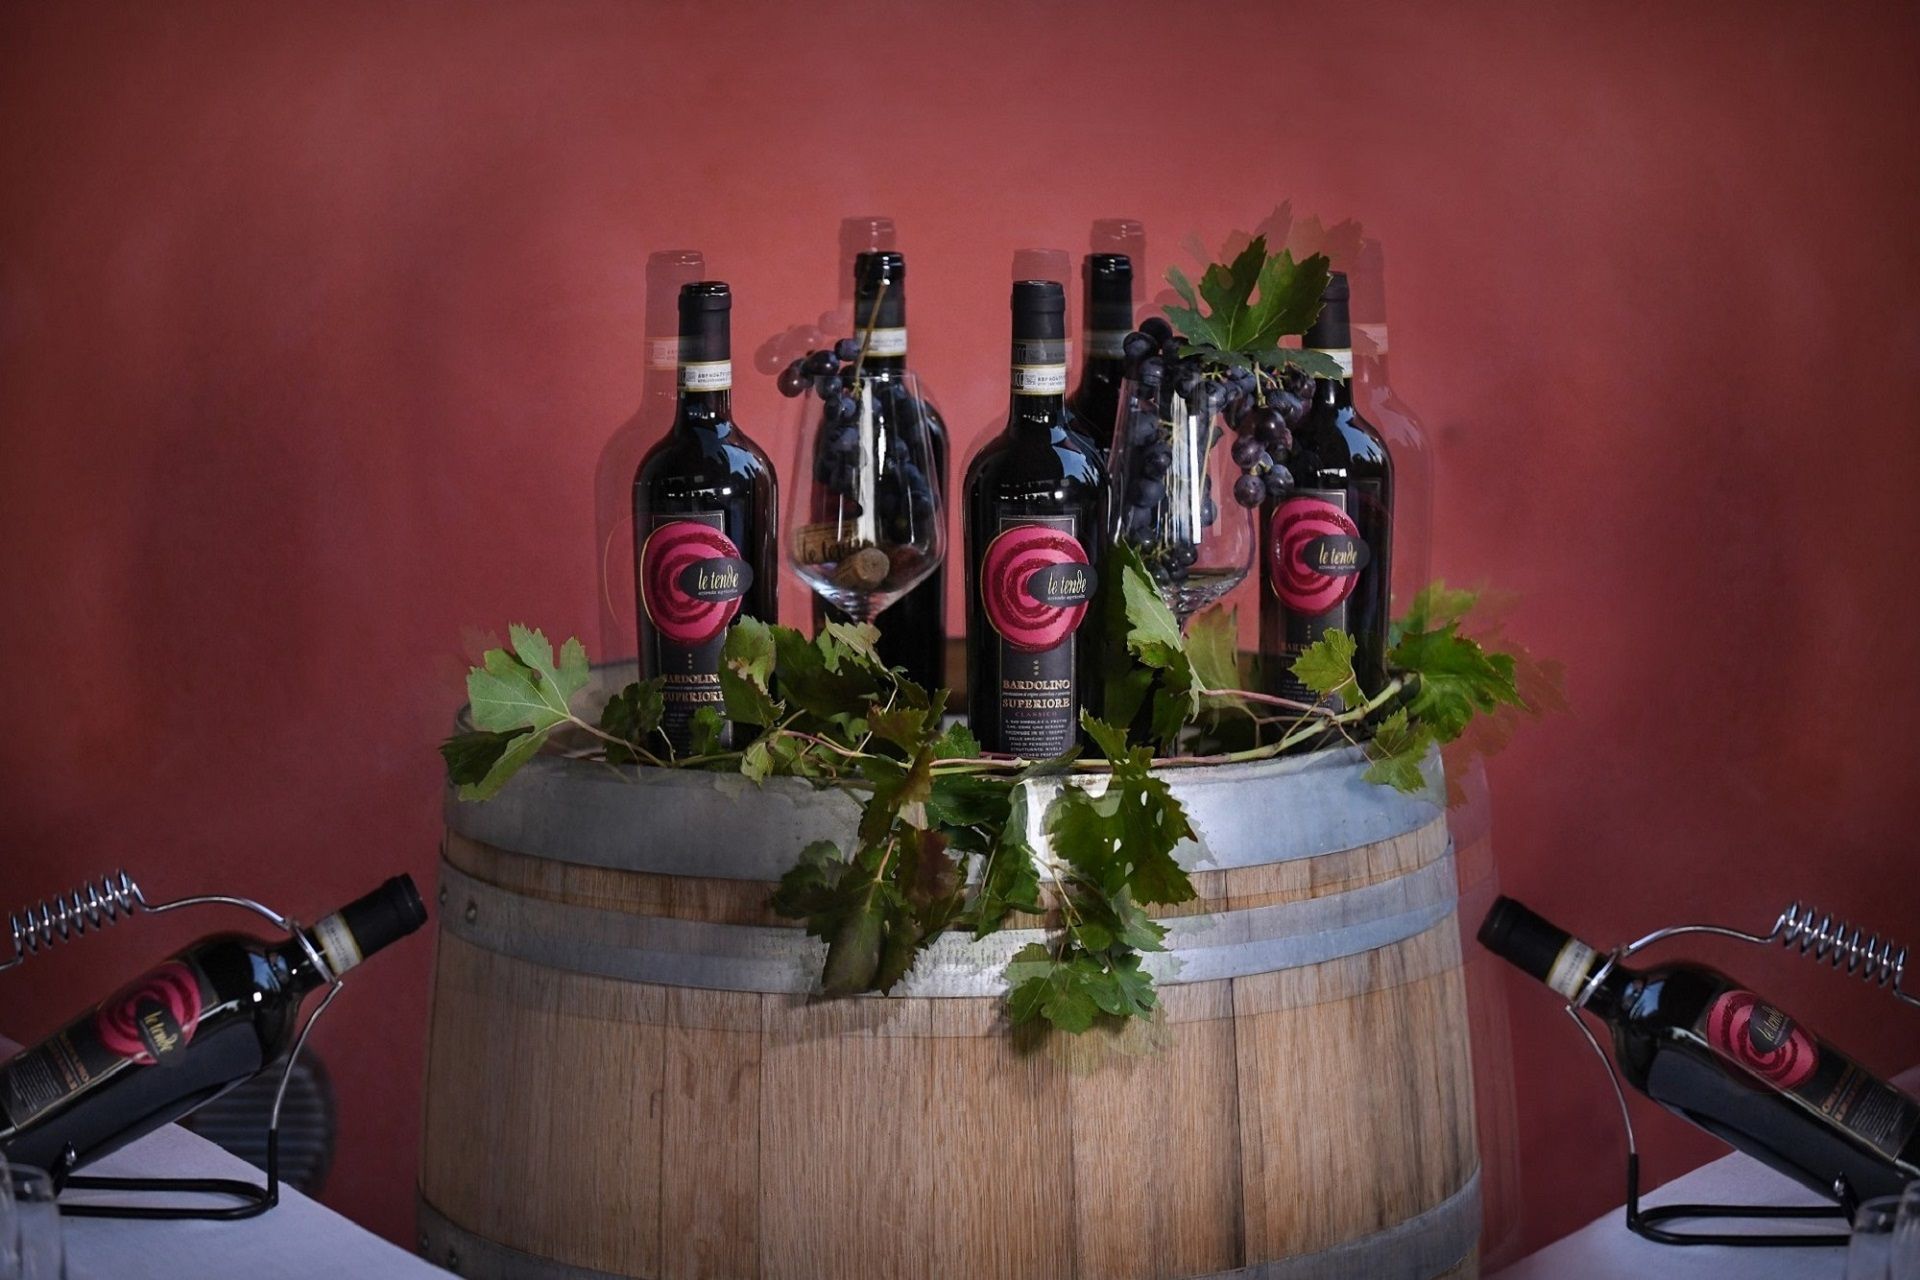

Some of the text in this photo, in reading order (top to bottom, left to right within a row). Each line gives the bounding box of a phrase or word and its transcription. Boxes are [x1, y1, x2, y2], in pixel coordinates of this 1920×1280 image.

[1319, 541, 1358, 564] le tende
[698, 564, 739, 590] le tende
[1047, 569, 1087, 594] le tende
[1002, 679, 1071, 690] BARDOLINO
[1002, 697, 1070, 709] SUPERIORE
